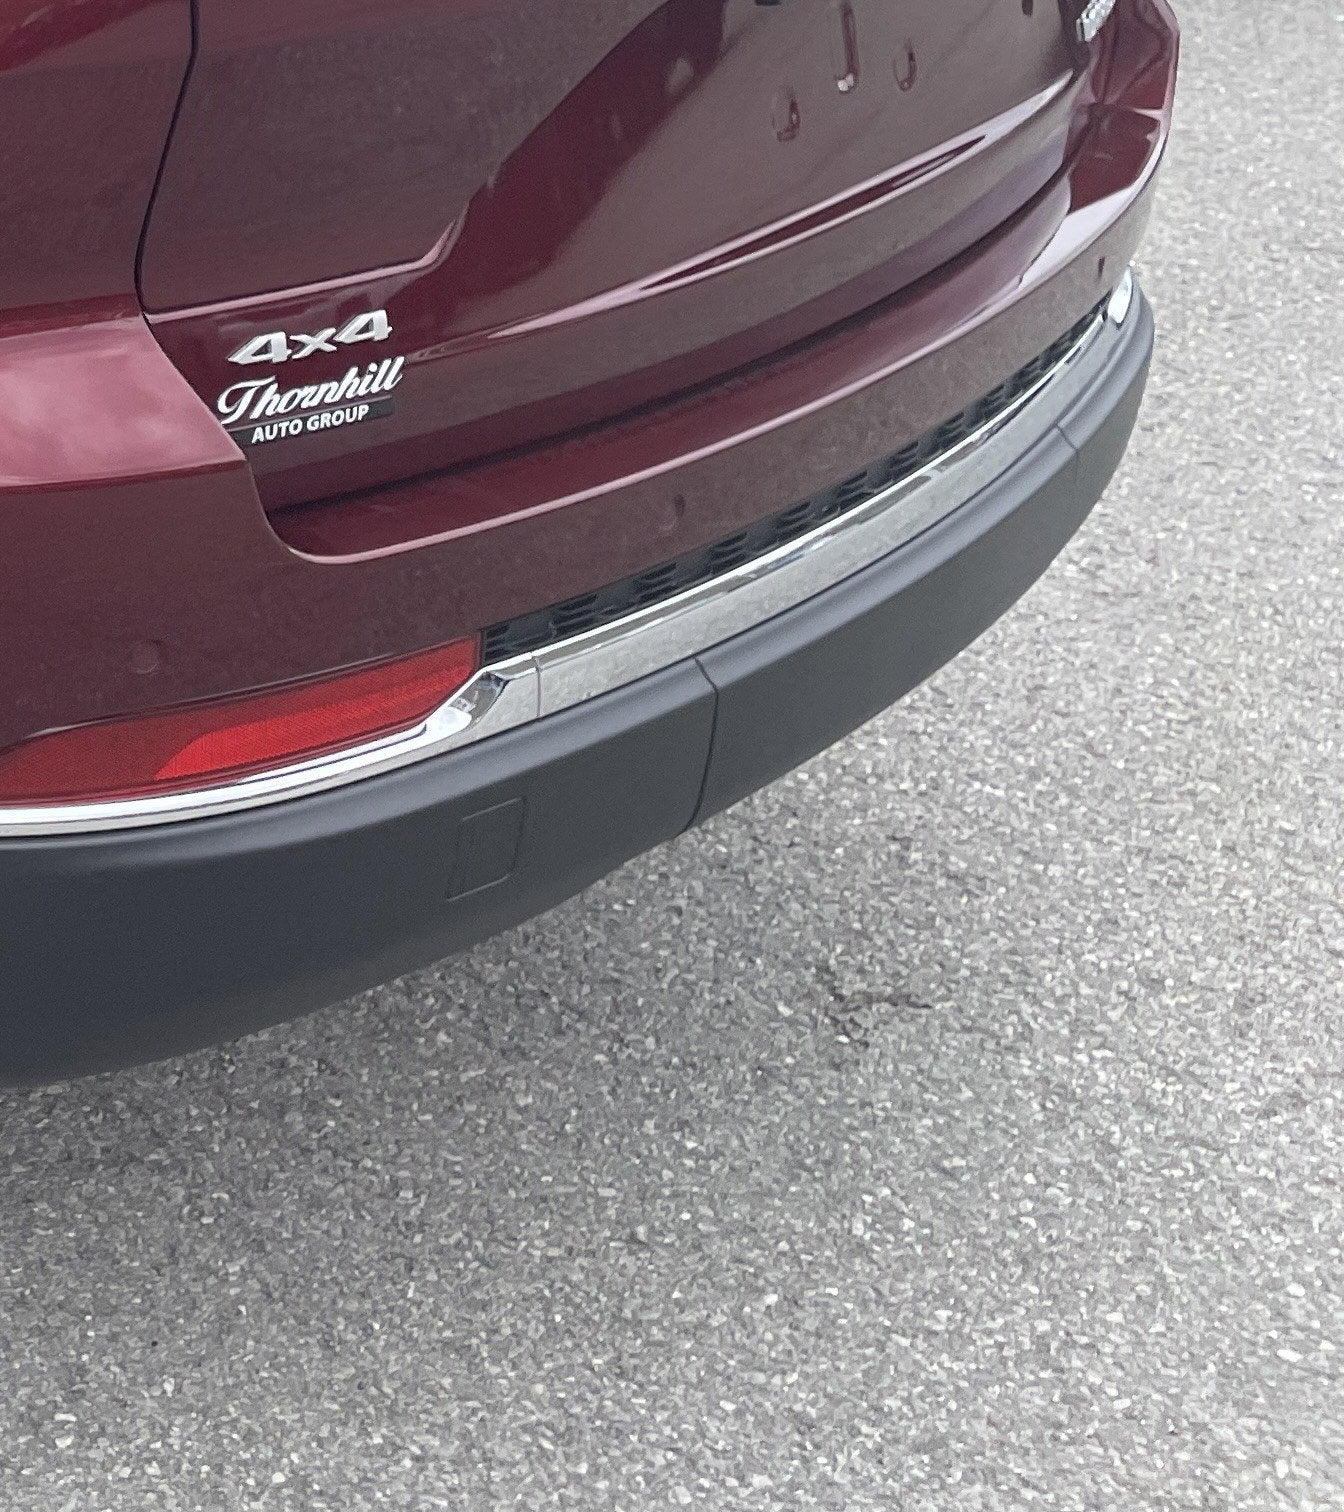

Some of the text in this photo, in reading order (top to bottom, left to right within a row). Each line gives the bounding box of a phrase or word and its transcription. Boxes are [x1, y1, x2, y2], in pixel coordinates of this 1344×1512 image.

[227, 309, 393, 365] 4x4
[217, 356, 405, 425] Thornhill
[252, 404, 370, 444] AUTO GROUP
